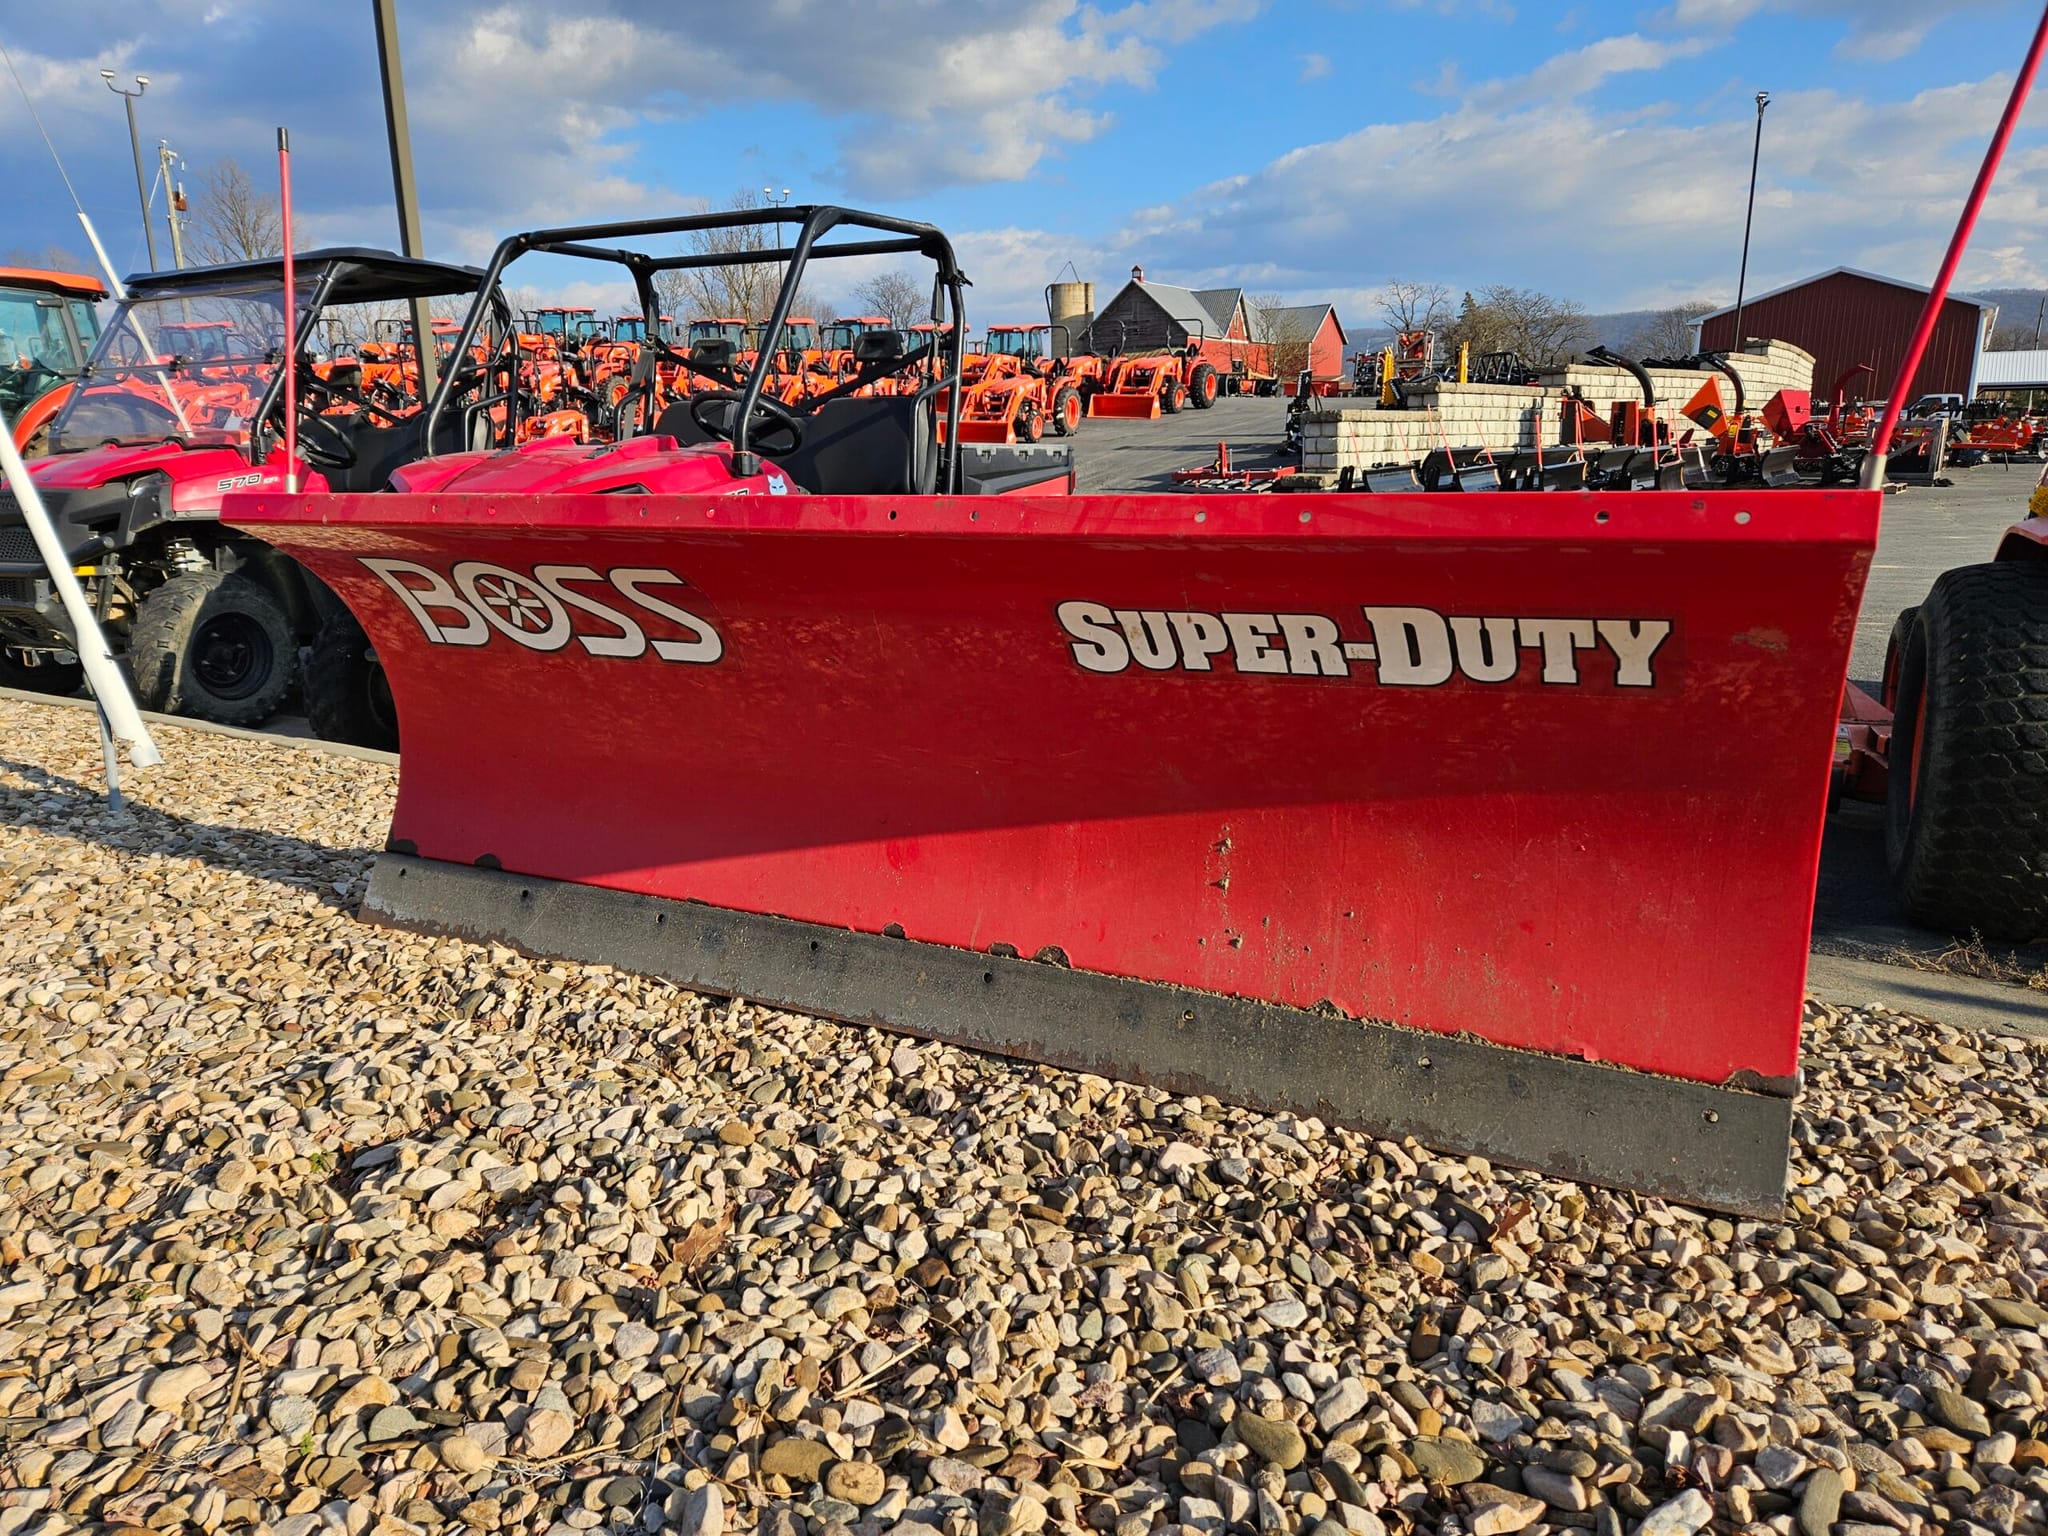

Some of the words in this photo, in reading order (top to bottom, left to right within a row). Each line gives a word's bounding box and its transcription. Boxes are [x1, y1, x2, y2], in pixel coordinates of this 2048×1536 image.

[217, 473, 261, 491] 570
[356, 557, 723, 664] BOSS
[1056, 600, 1672, 687] SUPER-DUTY
